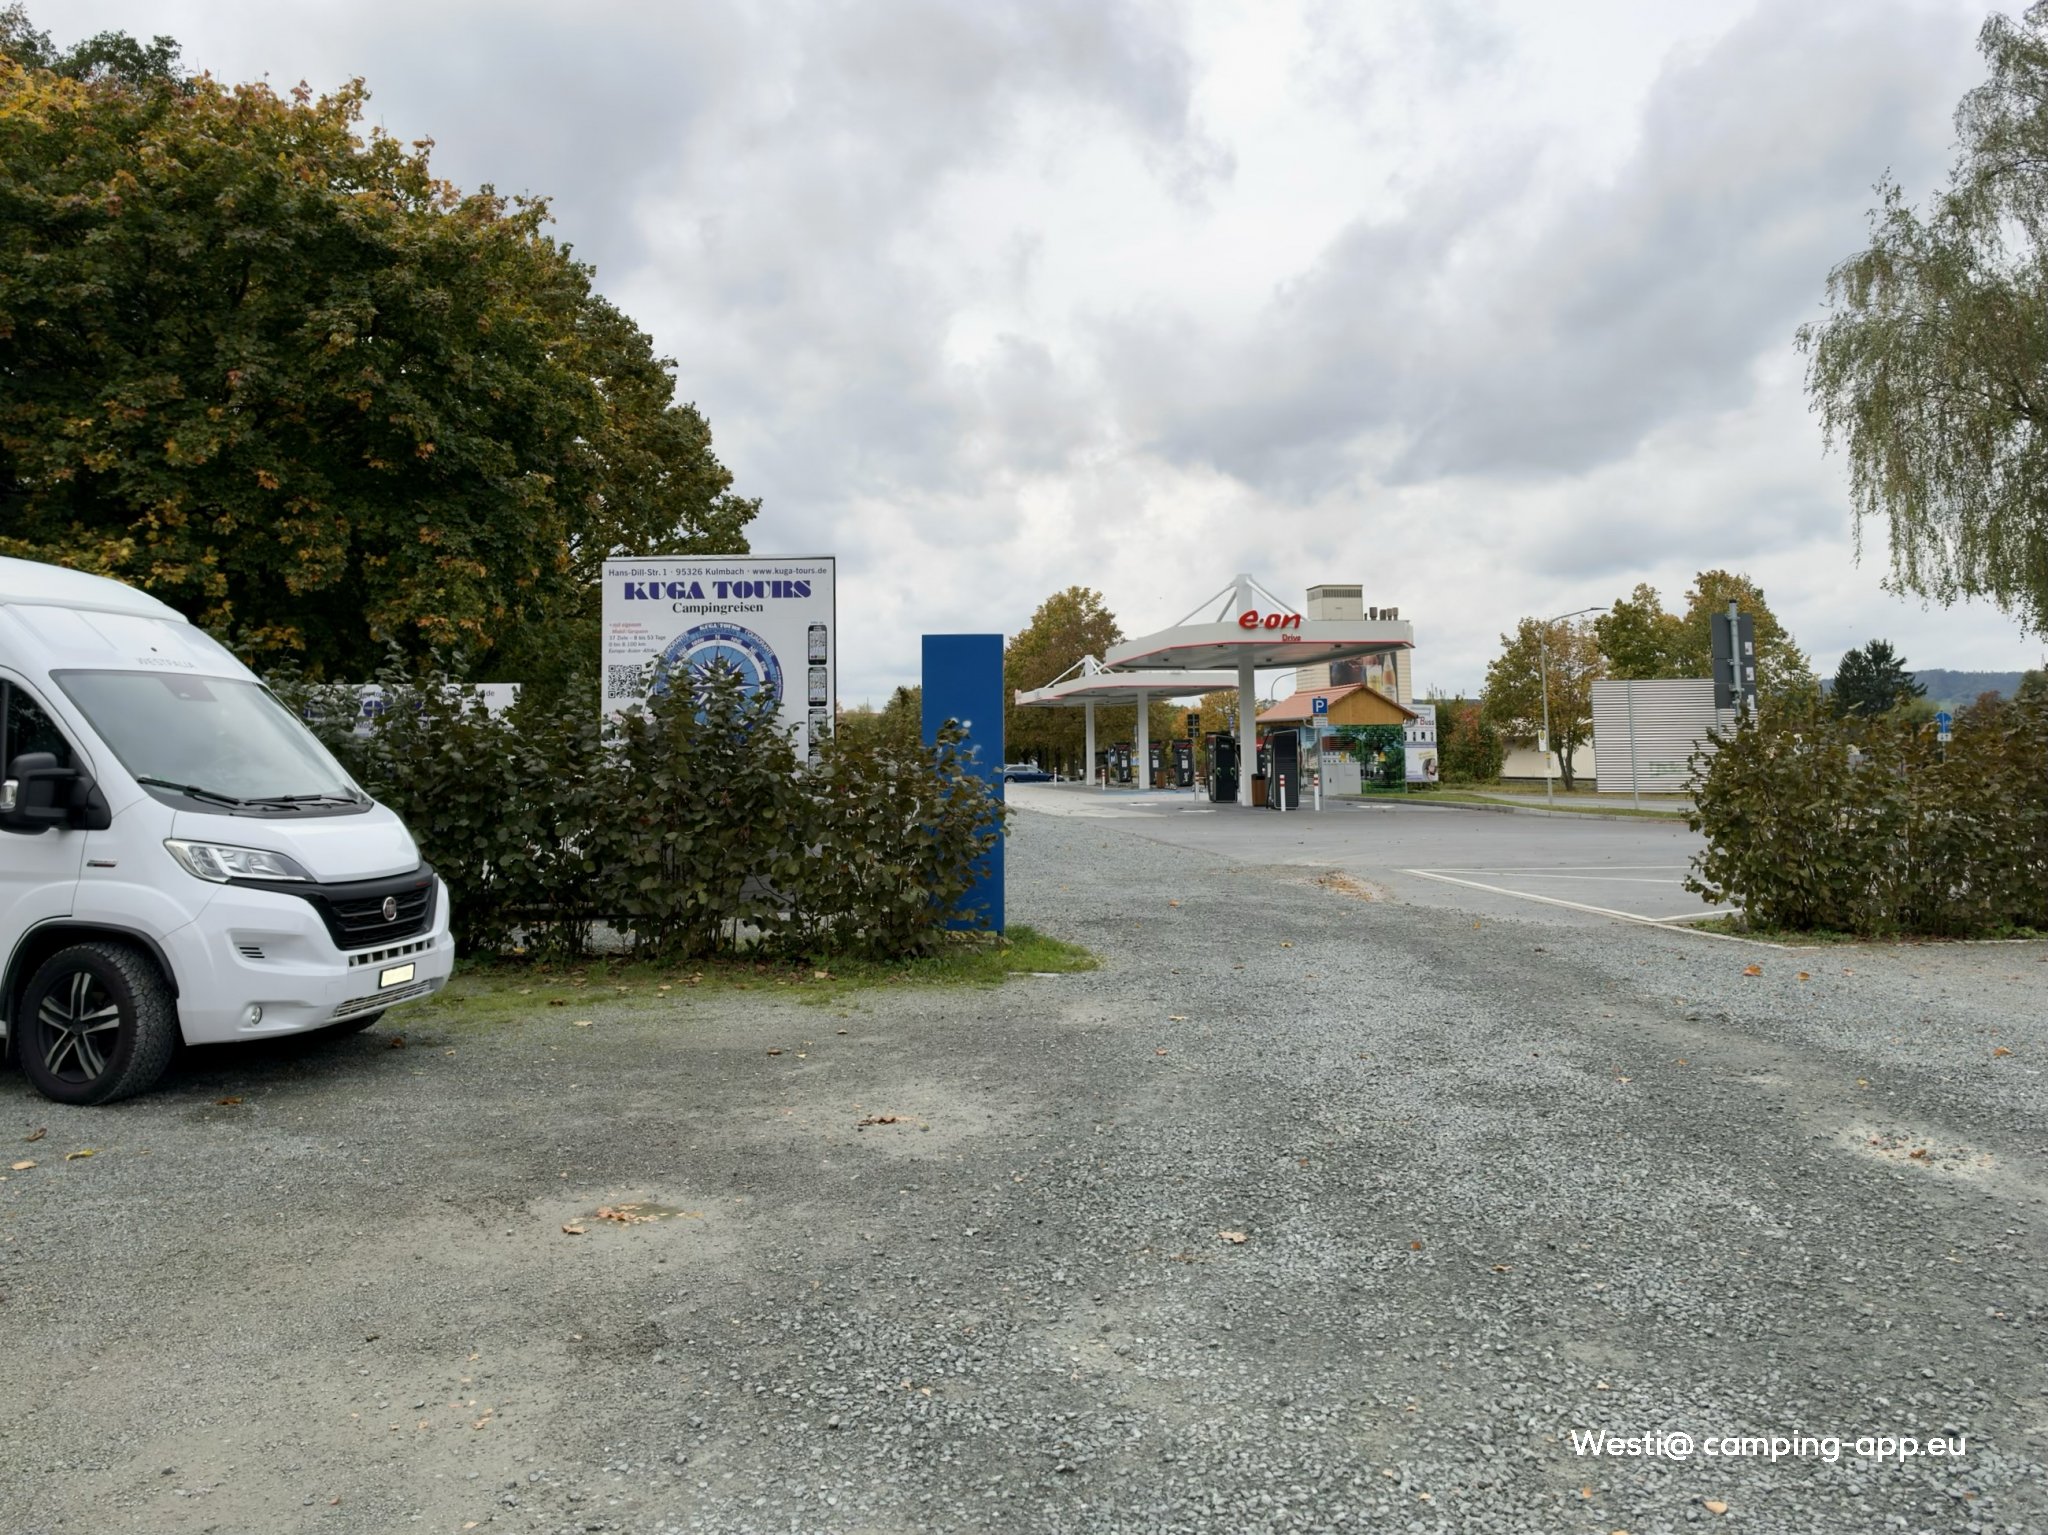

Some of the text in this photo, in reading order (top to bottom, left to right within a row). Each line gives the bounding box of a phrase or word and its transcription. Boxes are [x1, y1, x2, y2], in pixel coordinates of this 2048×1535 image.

[609, 567, 827, 577] Hans-Dill-Str. 1 95326 Kulmbach www.kuga-tours.de
[624, 580, 812, 600] KUGA TOURS
[672, 602, 764, 615] Campingreisen
[1282, 633, 1302, 642] Drive
[1316, 700, 1325, 713] P
